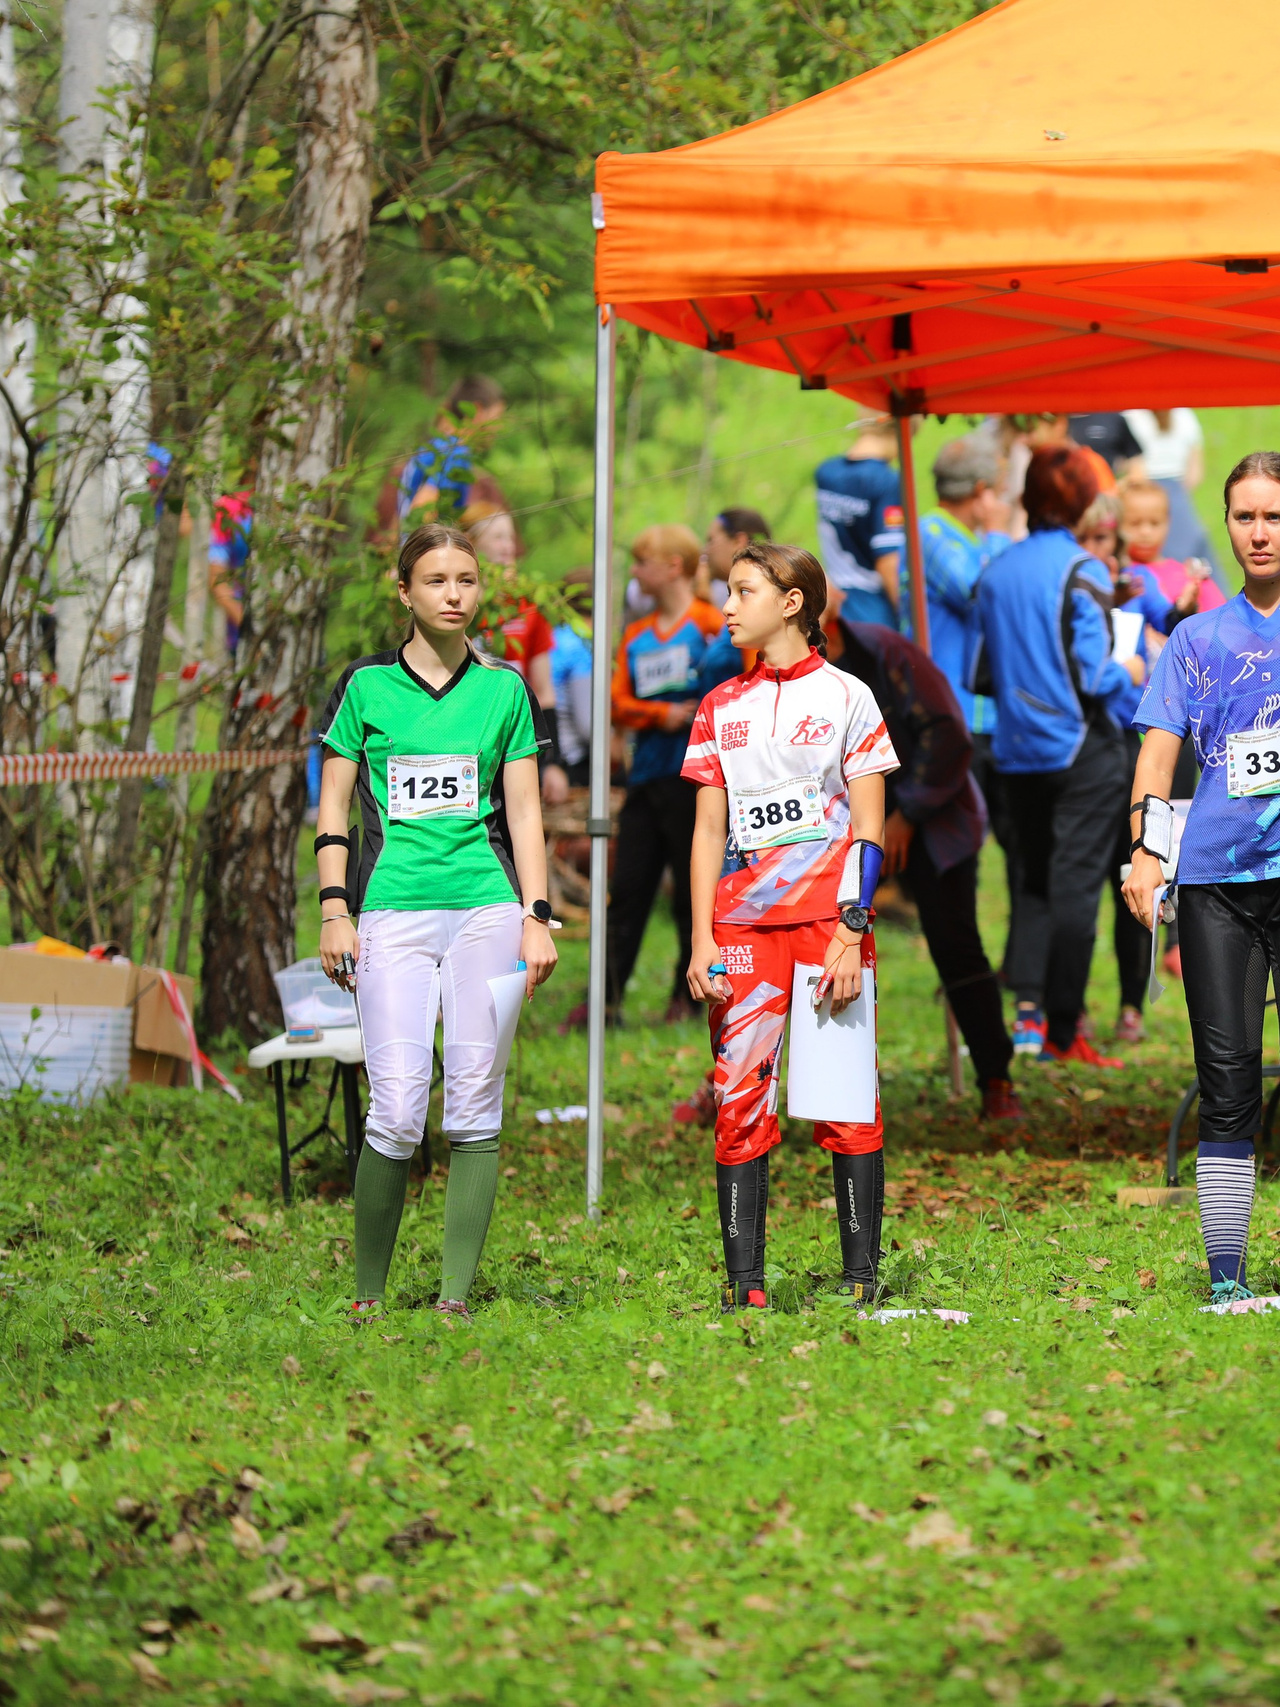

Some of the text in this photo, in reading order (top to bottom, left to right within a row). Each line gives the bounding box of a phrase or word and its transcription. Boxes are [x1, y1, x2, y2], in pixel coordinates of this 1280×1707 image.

[721, 720, 751, 733] EKAT
[720, 739, 748, 751] BURG
[721, 730, 750, 743] ERIN
[1245, 750, 1280, 775] 33
[402, 776, 458, 799] 125
[748, 799, 803, 829] 388
[719, 945, 753, 956] EKAT
[726, 964, 754, 975] URG
[730, 1182, 738, 1224] NORD
[847, 1177, 857, 1219] NORD
